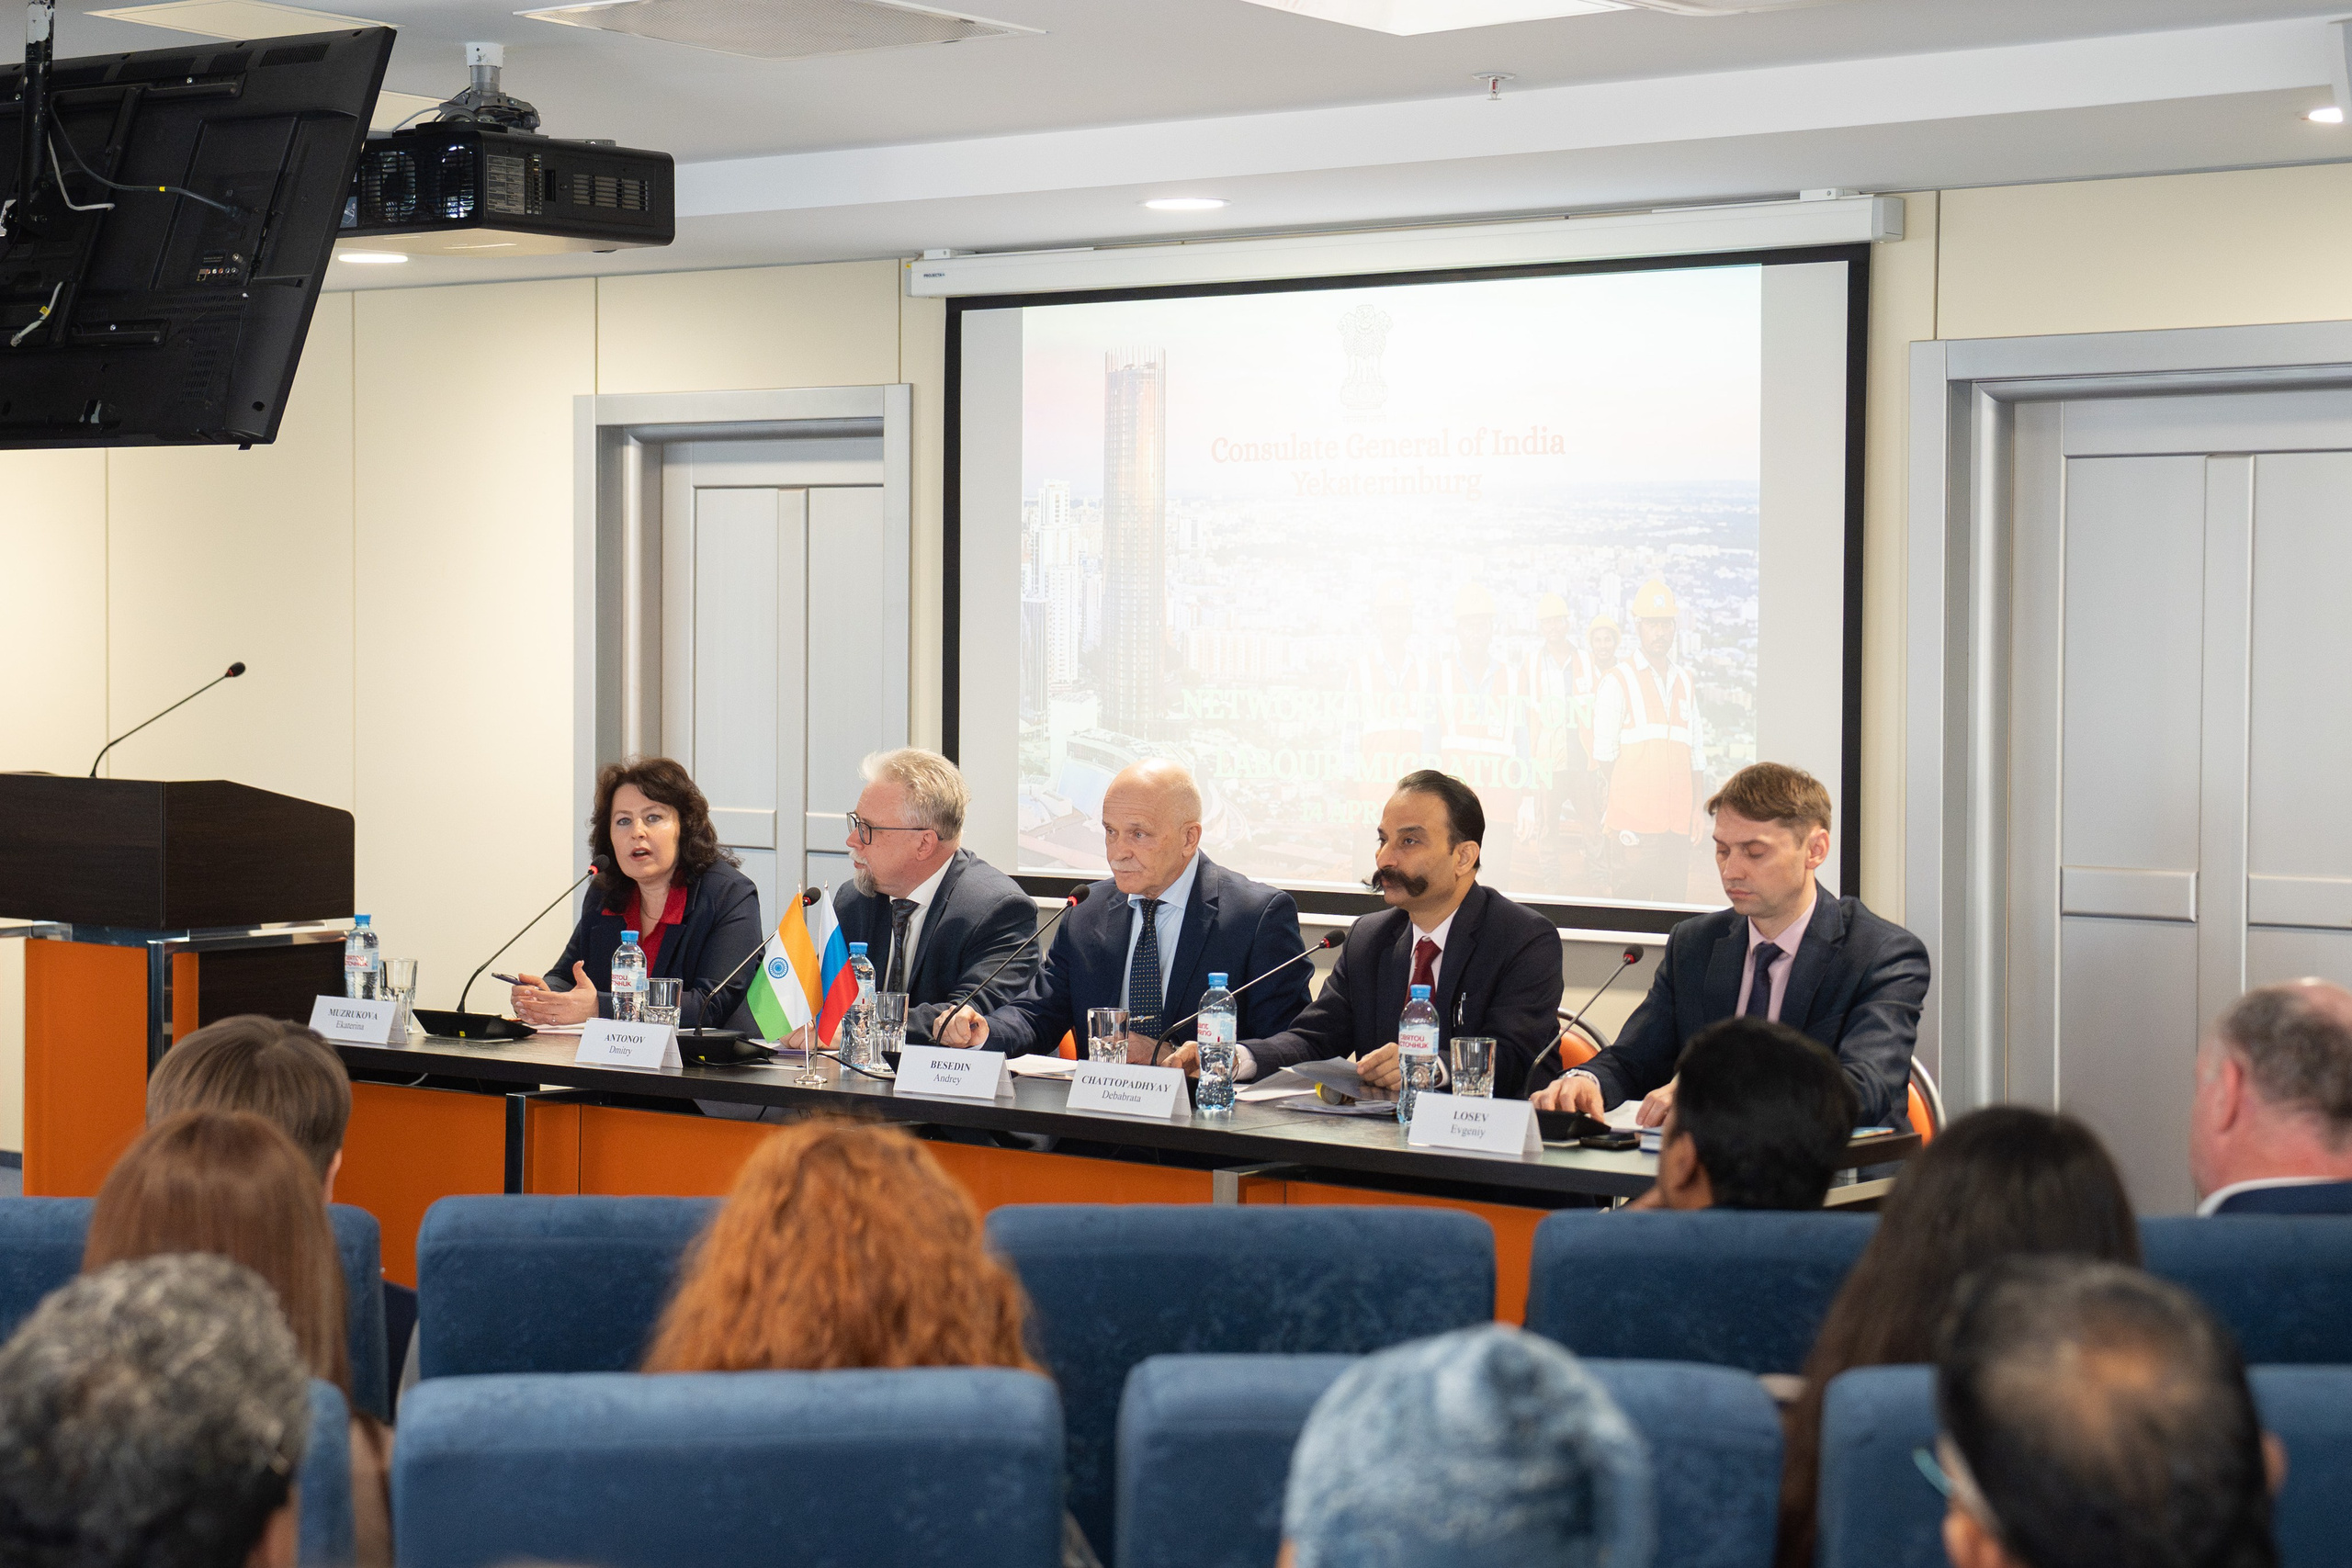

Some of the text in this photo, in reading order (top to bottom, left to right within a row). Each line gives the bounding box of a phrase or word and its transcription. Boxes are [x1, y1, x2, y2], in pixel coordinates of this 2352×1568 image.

[1211, 425, 1566, 463] Consulate General of India
[1291, 467, 1484, 502] Yekaterinburg
[1181, 688, 1597, 729] NETWORKING EVENT ON
[1213, 747, 1346, 781] LABOUR
[1299, 799, 1385, 825] 14 APR
[328, 1009, 378, 1020] MUZRUKOVA
[335, 1020, 364, 1030] Ekaterina
[605, 1033, 646, 1043] ANTONOV
[609, 1045, 632, 1056] Dmitry
[930, 1060, 971, 1071] BESEDIN
[933, 1073, 962, 1085] Andrey
[1081, 1075, 1171, 1092] CHATTOPADHYAY
[1102, 1089, 1141, 1102] Debabrata
[1453, 1111, 1489, 1122] LOSEV
[1451, 1123, 1486, 1139] Evgeniy
